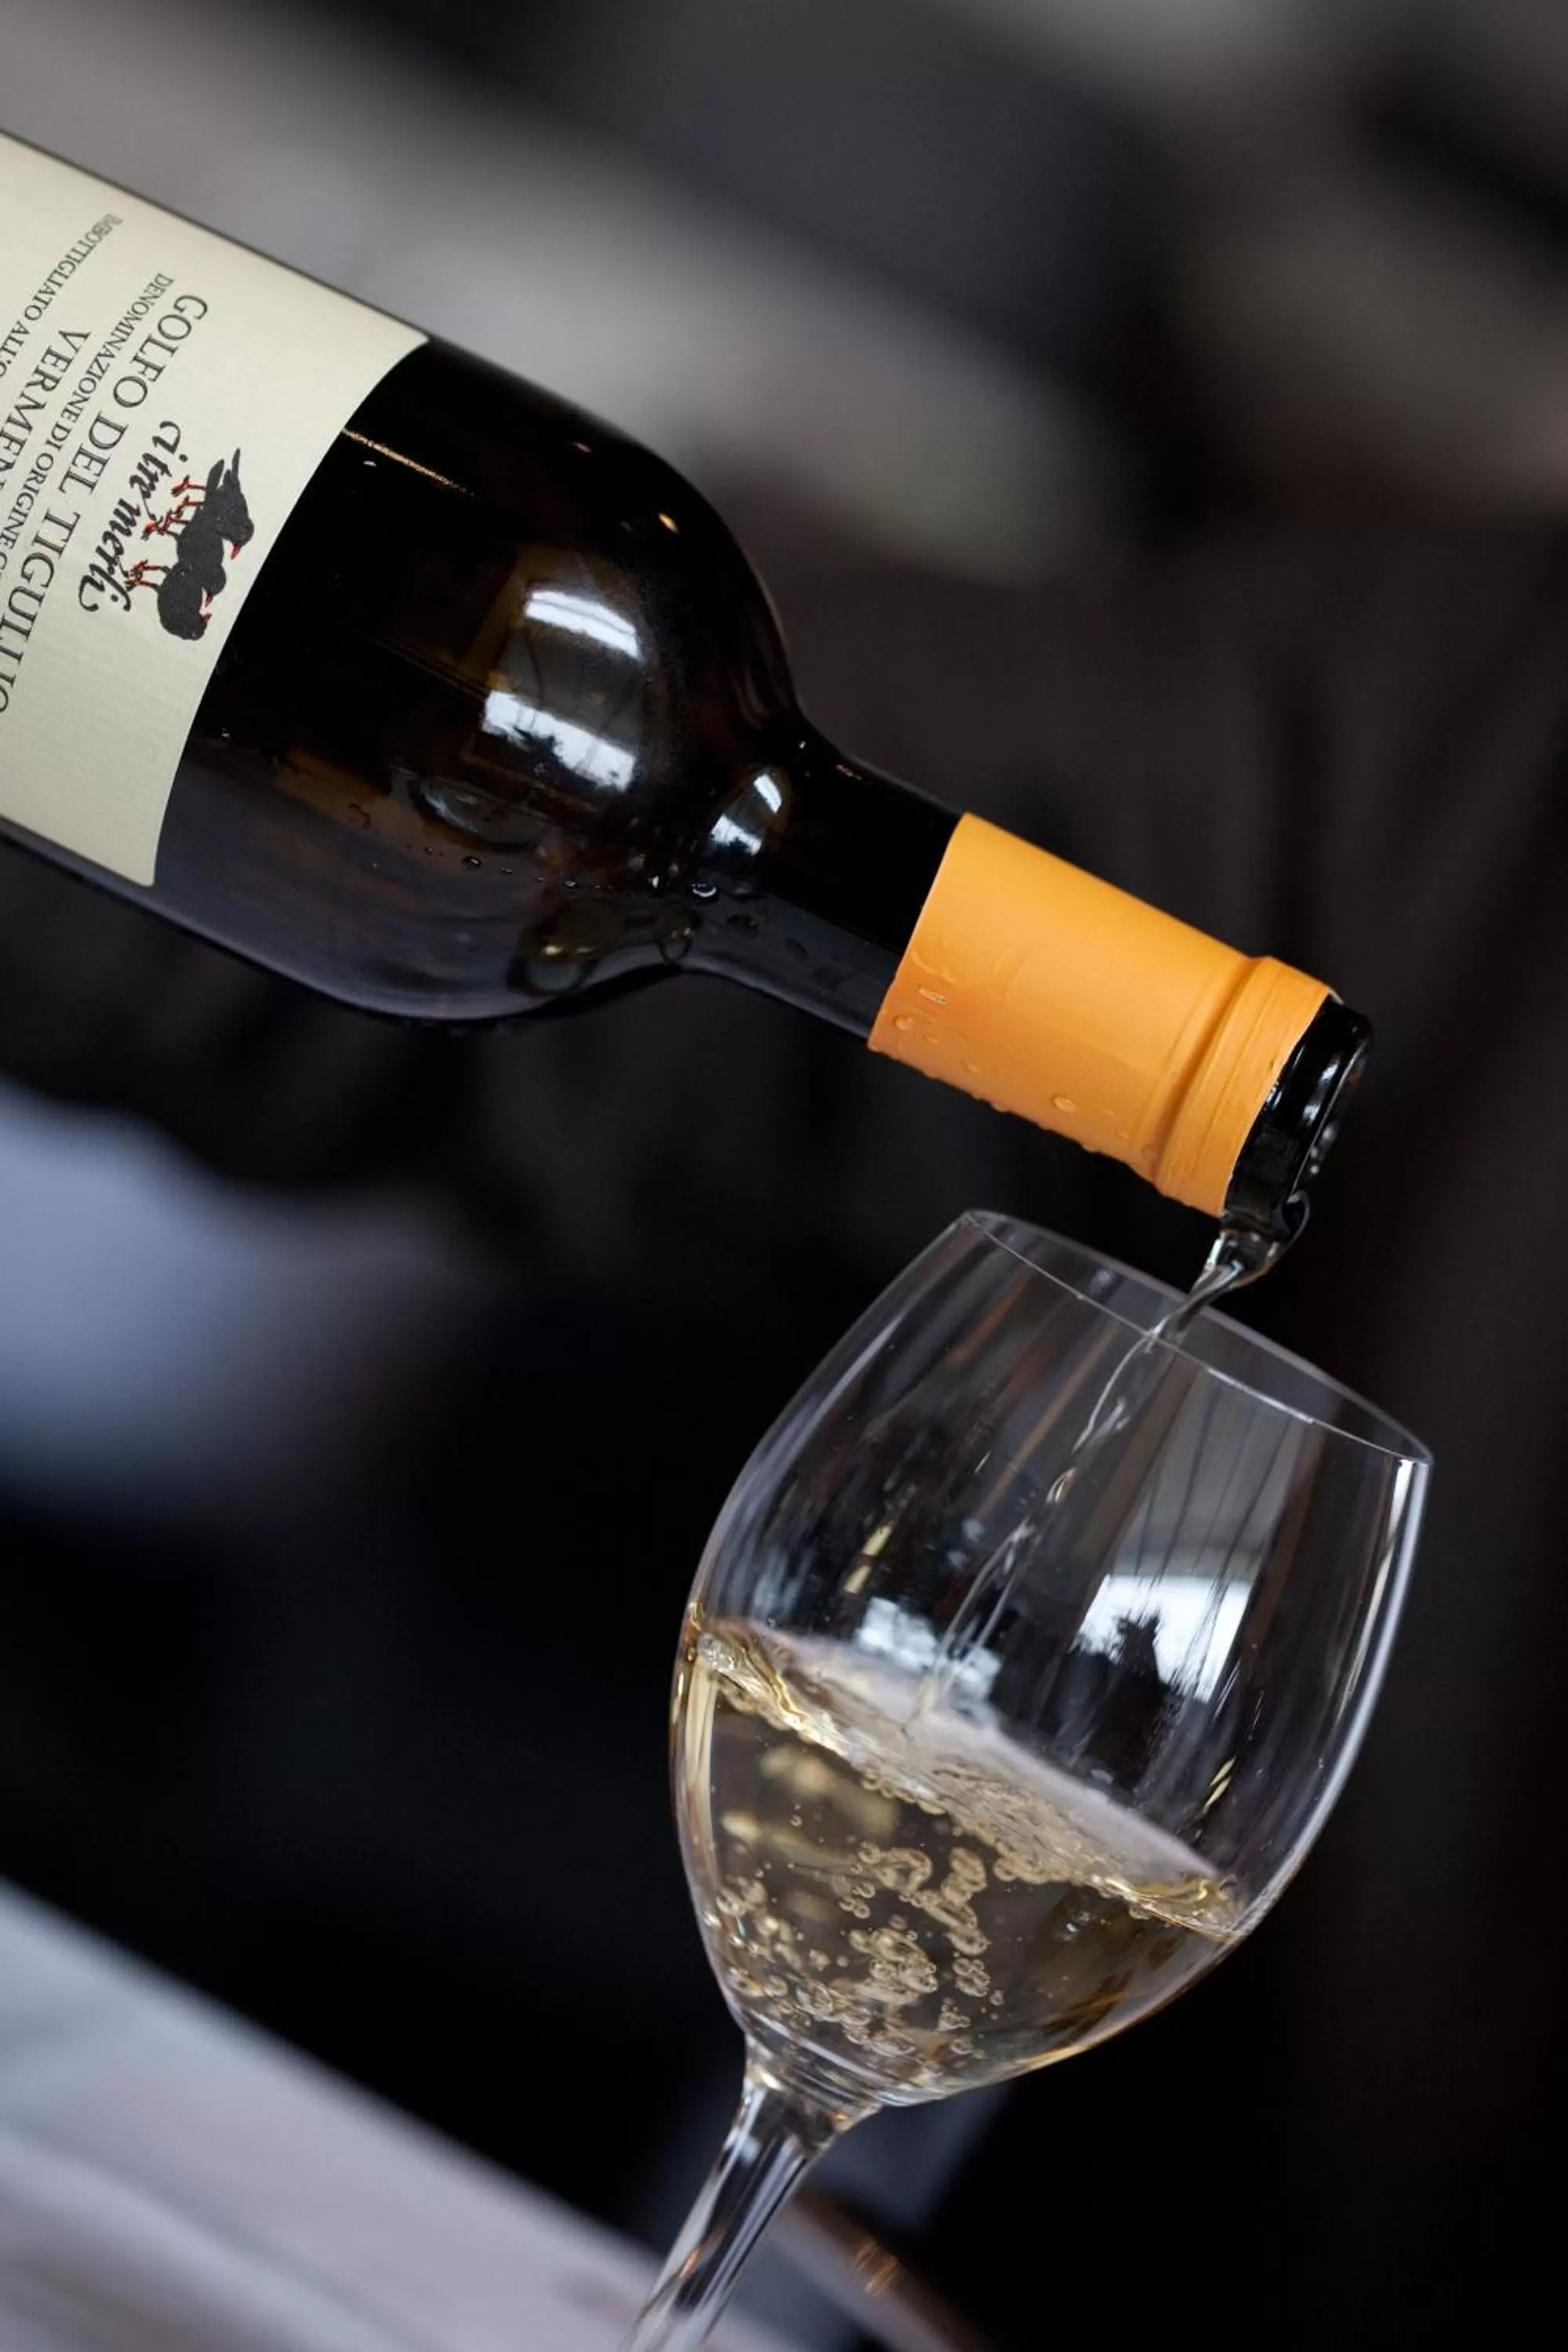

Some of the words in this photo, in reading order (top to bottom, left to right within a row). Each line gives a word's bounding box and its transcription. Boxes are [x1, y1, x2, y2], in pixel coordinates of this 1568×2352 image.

[60, 272, 175, 424] DENOMINAZIONE
[113, 294, 209, 408] GOLFO
[45, 422, 71, 452] DI
[58, 411, 129, 495] DEL
[0, 452, 54, 550] ORIGINE
[78, 498, 142, 612] merli
